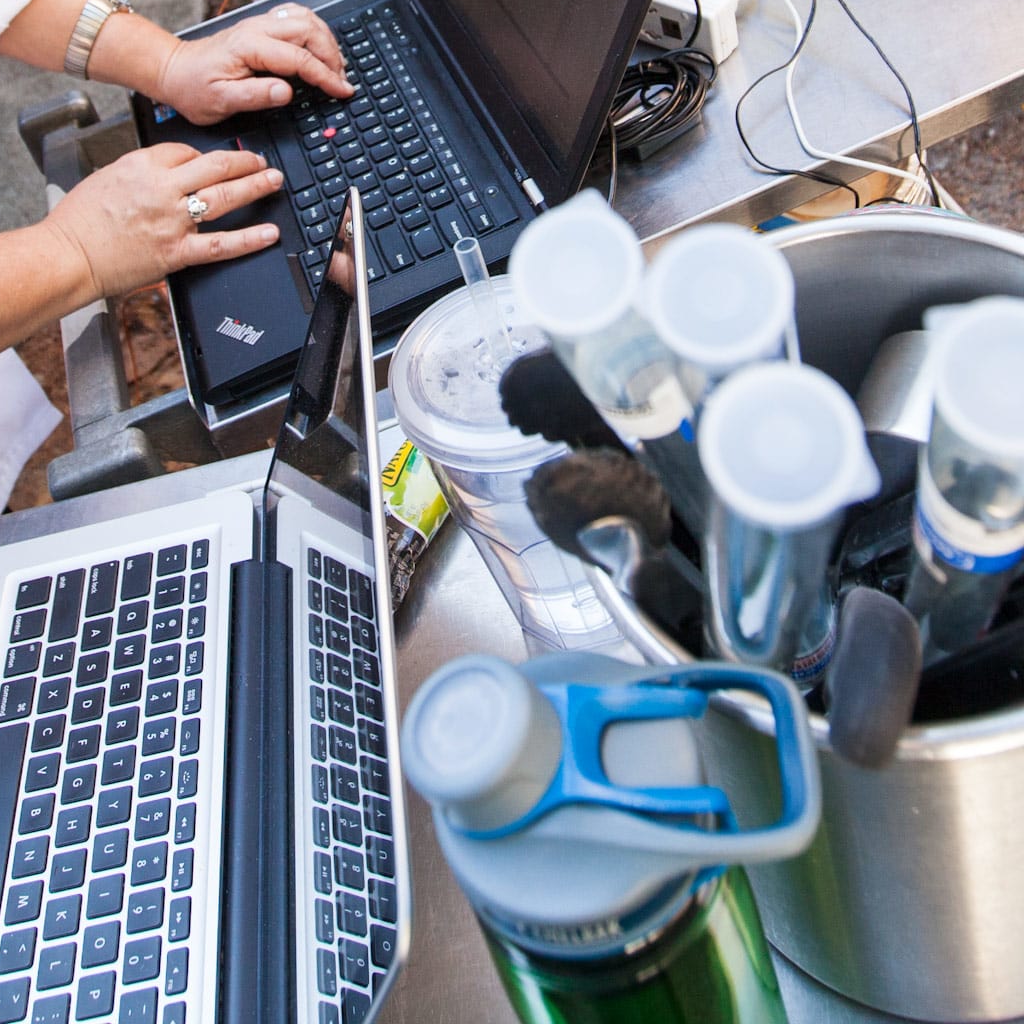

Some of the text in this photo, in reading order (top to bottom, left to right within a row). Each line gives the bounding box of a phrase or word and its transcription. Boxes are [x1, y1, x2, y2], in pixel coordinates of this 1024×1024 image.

[319, 145, 328, 153] N
[326, 160, 335, 169] M
[355, 157, 365, 165] K
[216, 316, 265, 346] ThinkPad
[20, 584, 28, 592] fn
[126, 611, 137, 621] Q
[13, 615, 22, 636] control
[155, 622, 165, 630] 2
[91, 629, 101, 638] A
[124, 645, 134, 655] W
[7, 648, 16, 669] option
[53, 654, 63, 662] Z
[153, 657, 163, 665] 3
[120, 682, 130, 690] E
[48, 689, 58, 699] X
[0, 684, 11, 718] command
[82, 700, 93, 709] D
[116, 720, 127, 728] R
[42, 727, 53, 736] C
[37, 766, 48, 774] V
[143, 773, 153, 781] 6
[72, 778, 83, 788] G
[108, 800, 119, 809] Y
[31, 808, 41, 816] B
[140, 814, 151, 822] 7
[67, 820, 78, 830] H
[103, 843, 115, 854] U
[24, 850, 35, 861] N
[136, 860, 147, 868] 8
[17, 895, 29, 909] M
[132, 906, 143, 914] 9
[55, 910, 67, 922] K
[94, 937, 106, 949] O
[128, 956, 139, 965] 0
[49, 961, 61, 970] L
[89, 989, 101, 1000] P
